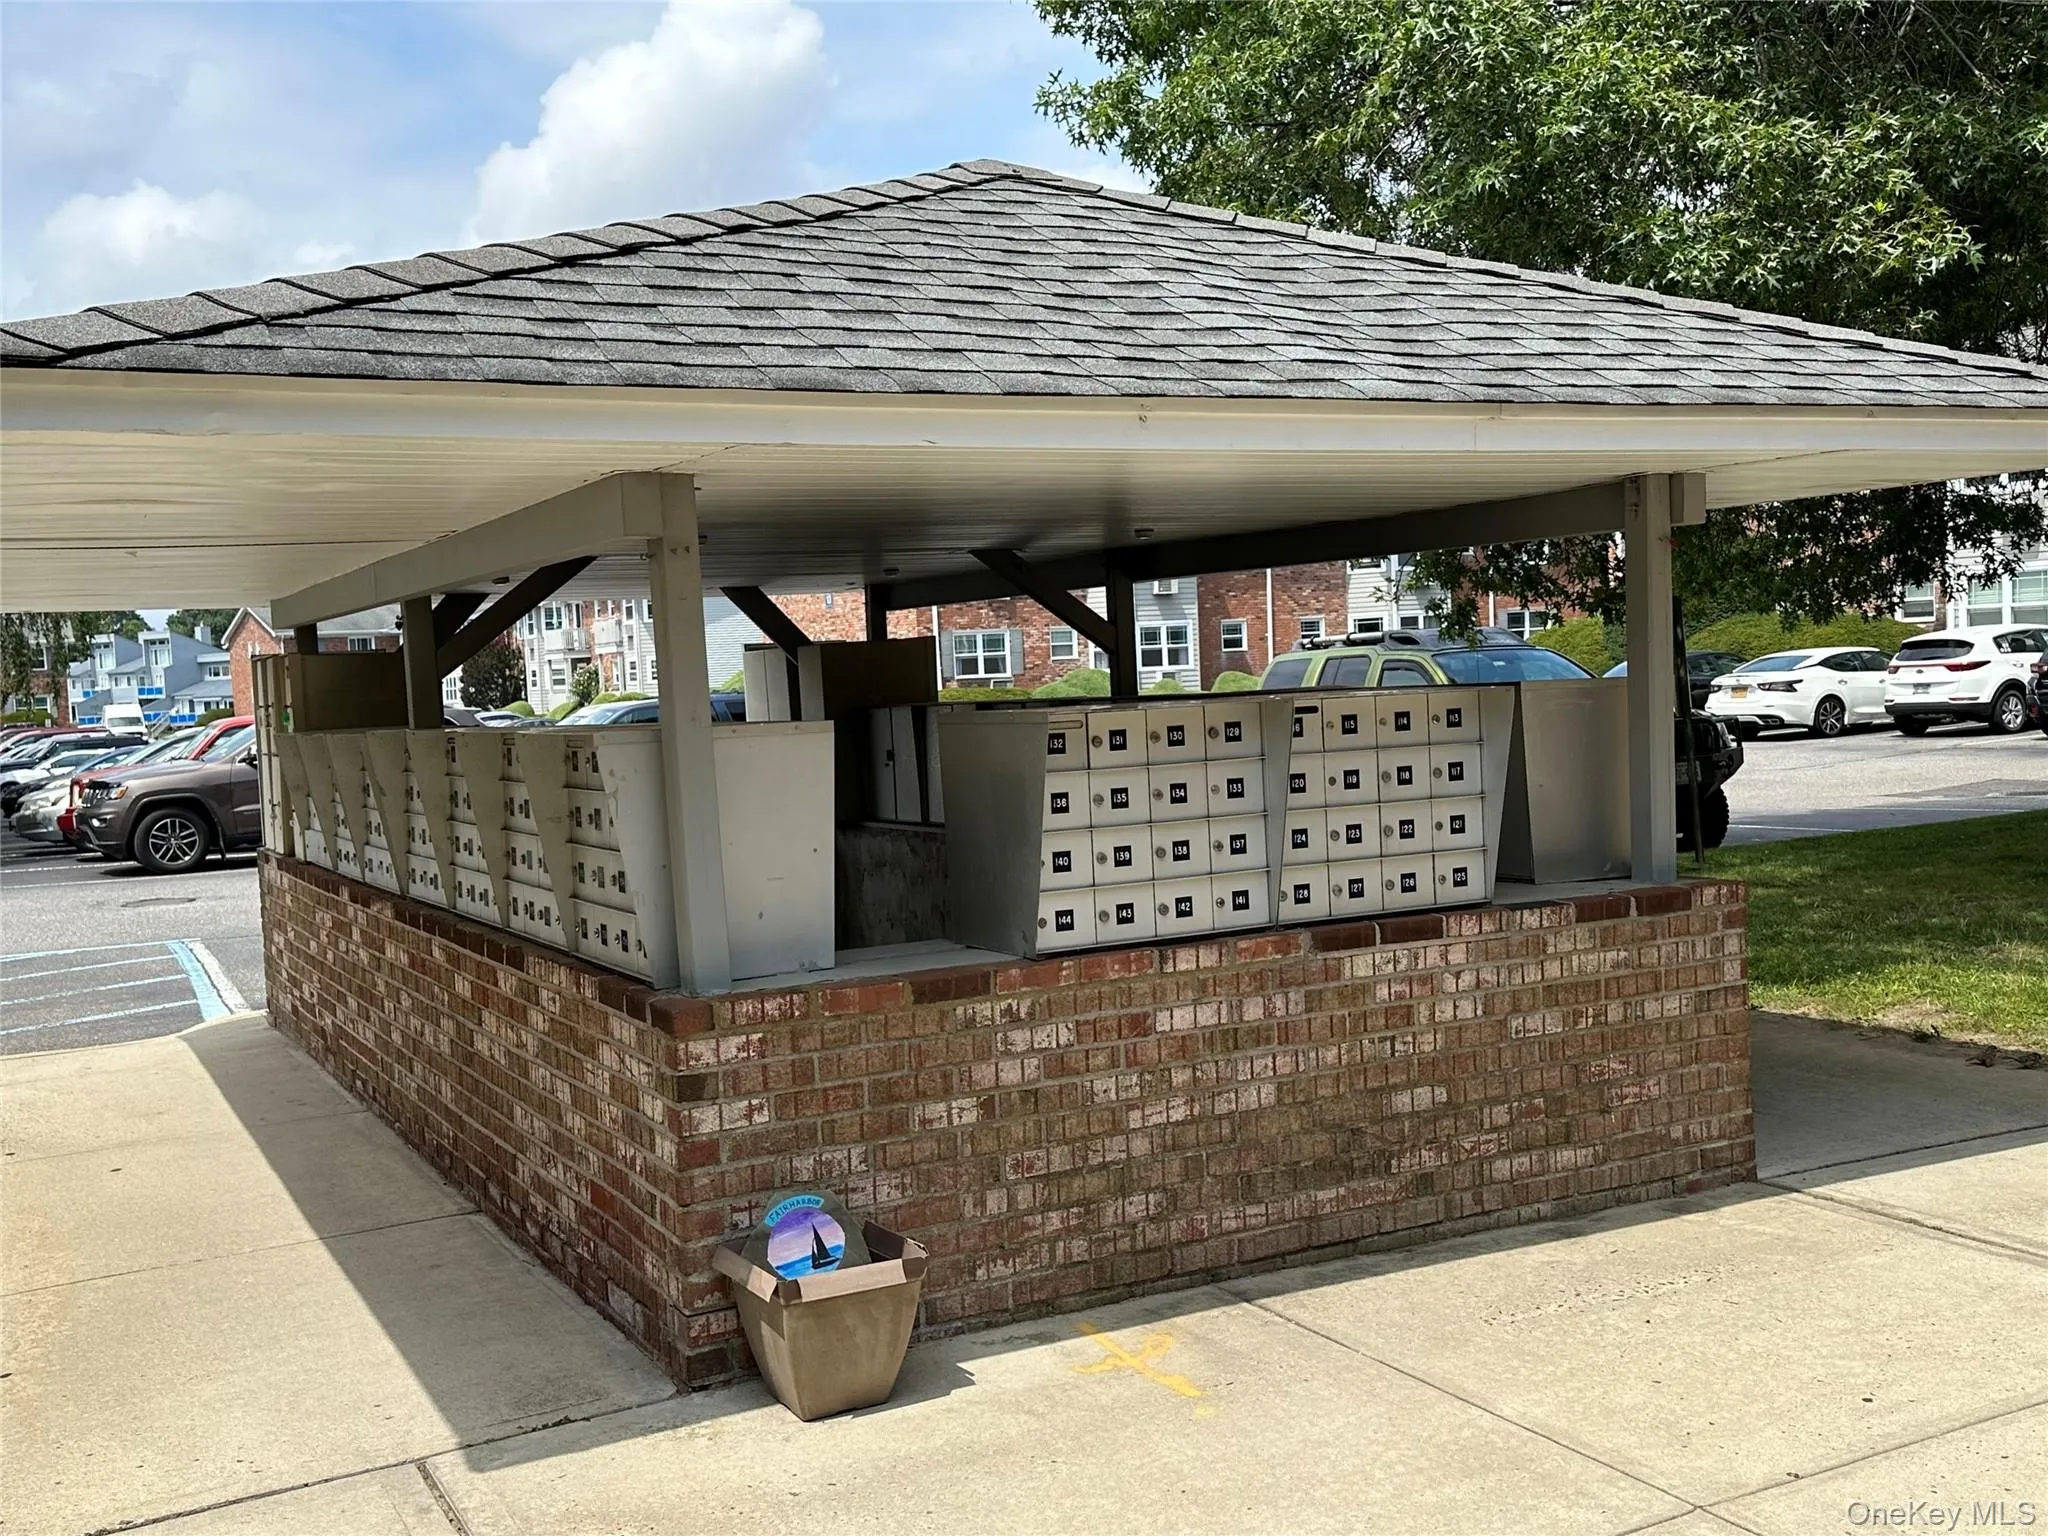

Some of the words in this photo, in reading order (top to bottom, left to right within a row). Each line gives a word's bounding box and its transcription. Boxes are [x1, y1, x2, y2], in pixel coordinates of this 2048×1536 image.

[1344, 719, 1355, 729] 115
[1112, 735, 1123, 745] 131
[1169, 731, 1183, 741] 130
[1050, 738, 1064, 749] 132
[1291, 778, 1305, 788] 120
[1346, 774, 1357, 784] 119
[1172, 788, 1185, 798] 134
[1229, 783, 1242, 793] 133
[1113, 792, 1127, 803] 135
[1401, 824, 1413, 834] 122
[1452, 819, 1463, 829] 121
[1294, 833, 1307, 844] 124
[1348, 828, 1361, 839] 123
[1232, 839, 1245, 849] 137
[1174, 845, 1188, 856] 138
[1055, 856, 1069, 866] 140
[1116, 851, 1130, 861] 139
[1454, 871, 1466, 882] 125
[1350, 882, 1363, 893] 127
[1235, 895, 1246, 905] 141
[1178, 901, 1191, 912] 142
[1119, 908, 1132, 919] 143
[1058, 914, 1072, 926] 144
